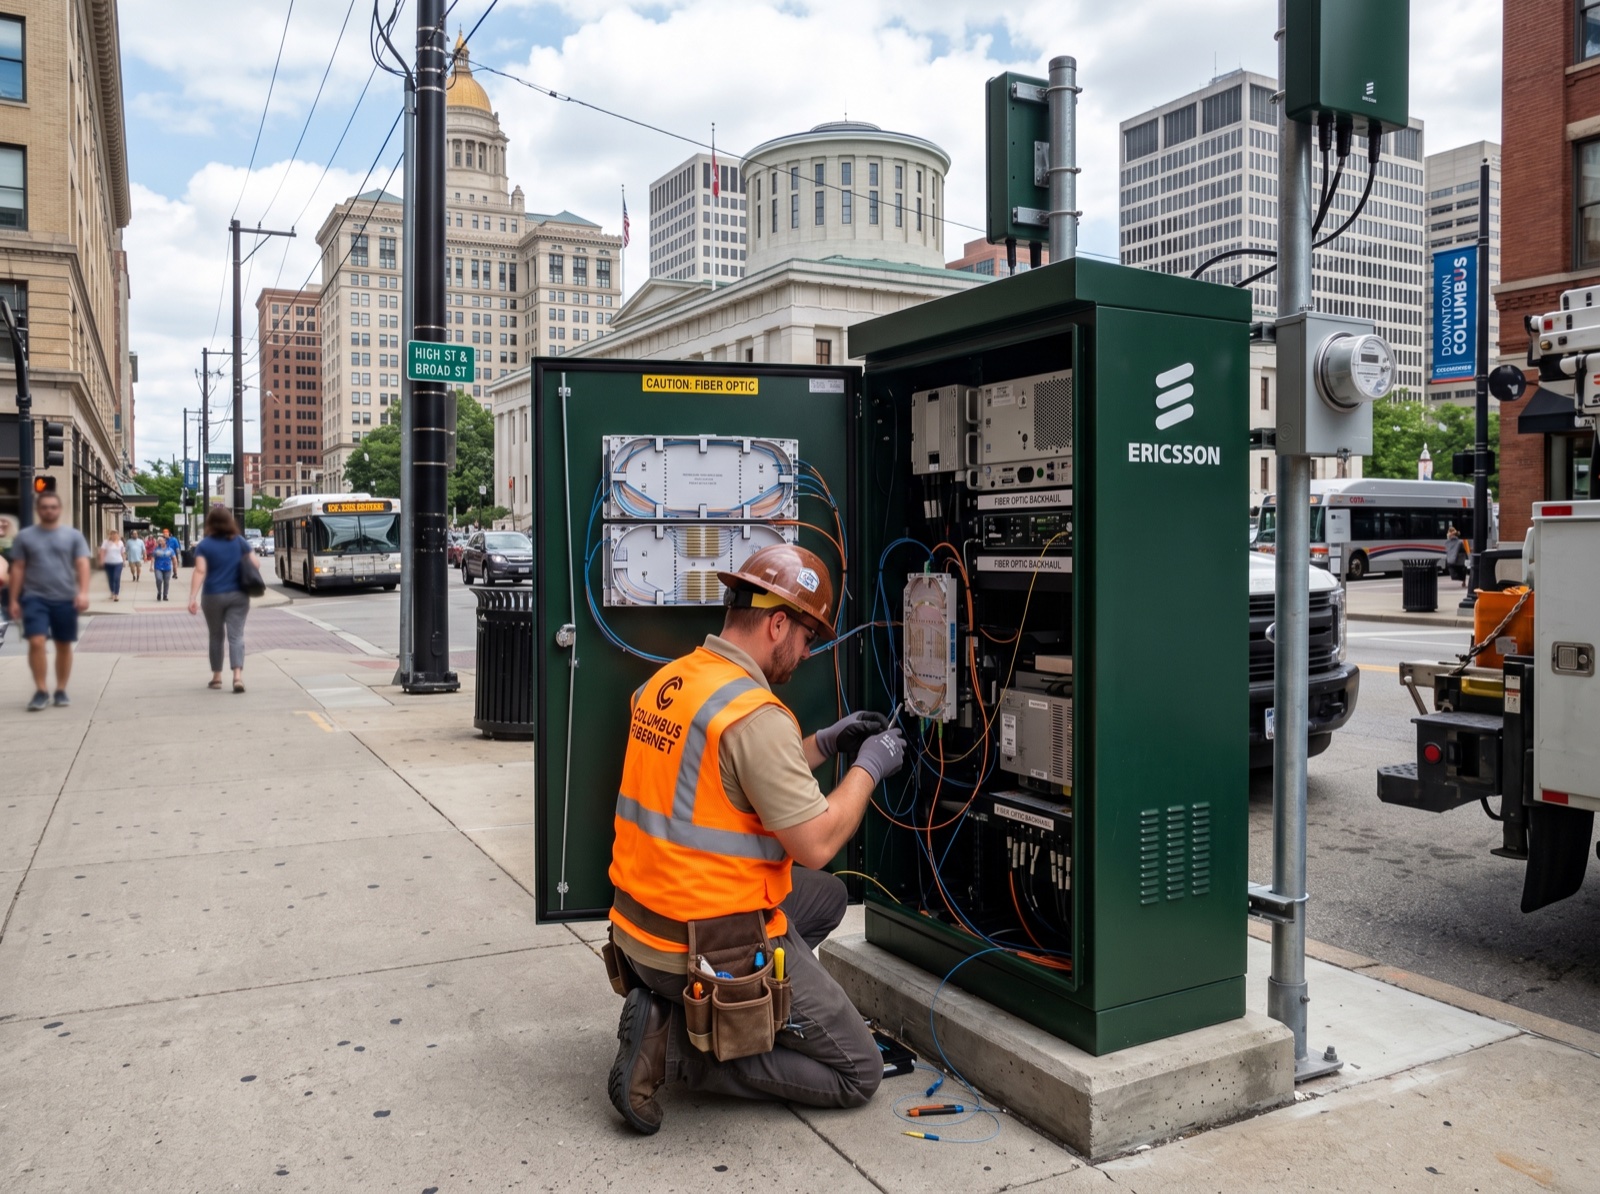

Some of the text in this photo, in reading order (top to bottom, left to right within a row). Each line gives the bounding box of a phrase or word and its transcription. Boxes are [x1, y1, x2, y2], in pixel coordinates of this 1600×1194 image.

[1453, 256, 1468, 355] COLUMBUS
[1442, 274, 1452, 356] DOWNTOWN
[415, 347, 468, 363] HIGH ST &
[415, 363, 467, 378] BROAD ST
[646, 377, 755, 392] CAUTION: FIBER OPTIC
[1128, 442, 1220, 466] ERICSSON
[994, 493, 1061, 506] FIBER OPTIC BACKHAUL
[1349, 496, 1365, 504] COTA
[994, 559, 1061, 570] FIBER OPTIC BACKHAUL
[634, 707, 682, 739] COLUMBUS
[631, 723, 675, 755] FIBERNET
